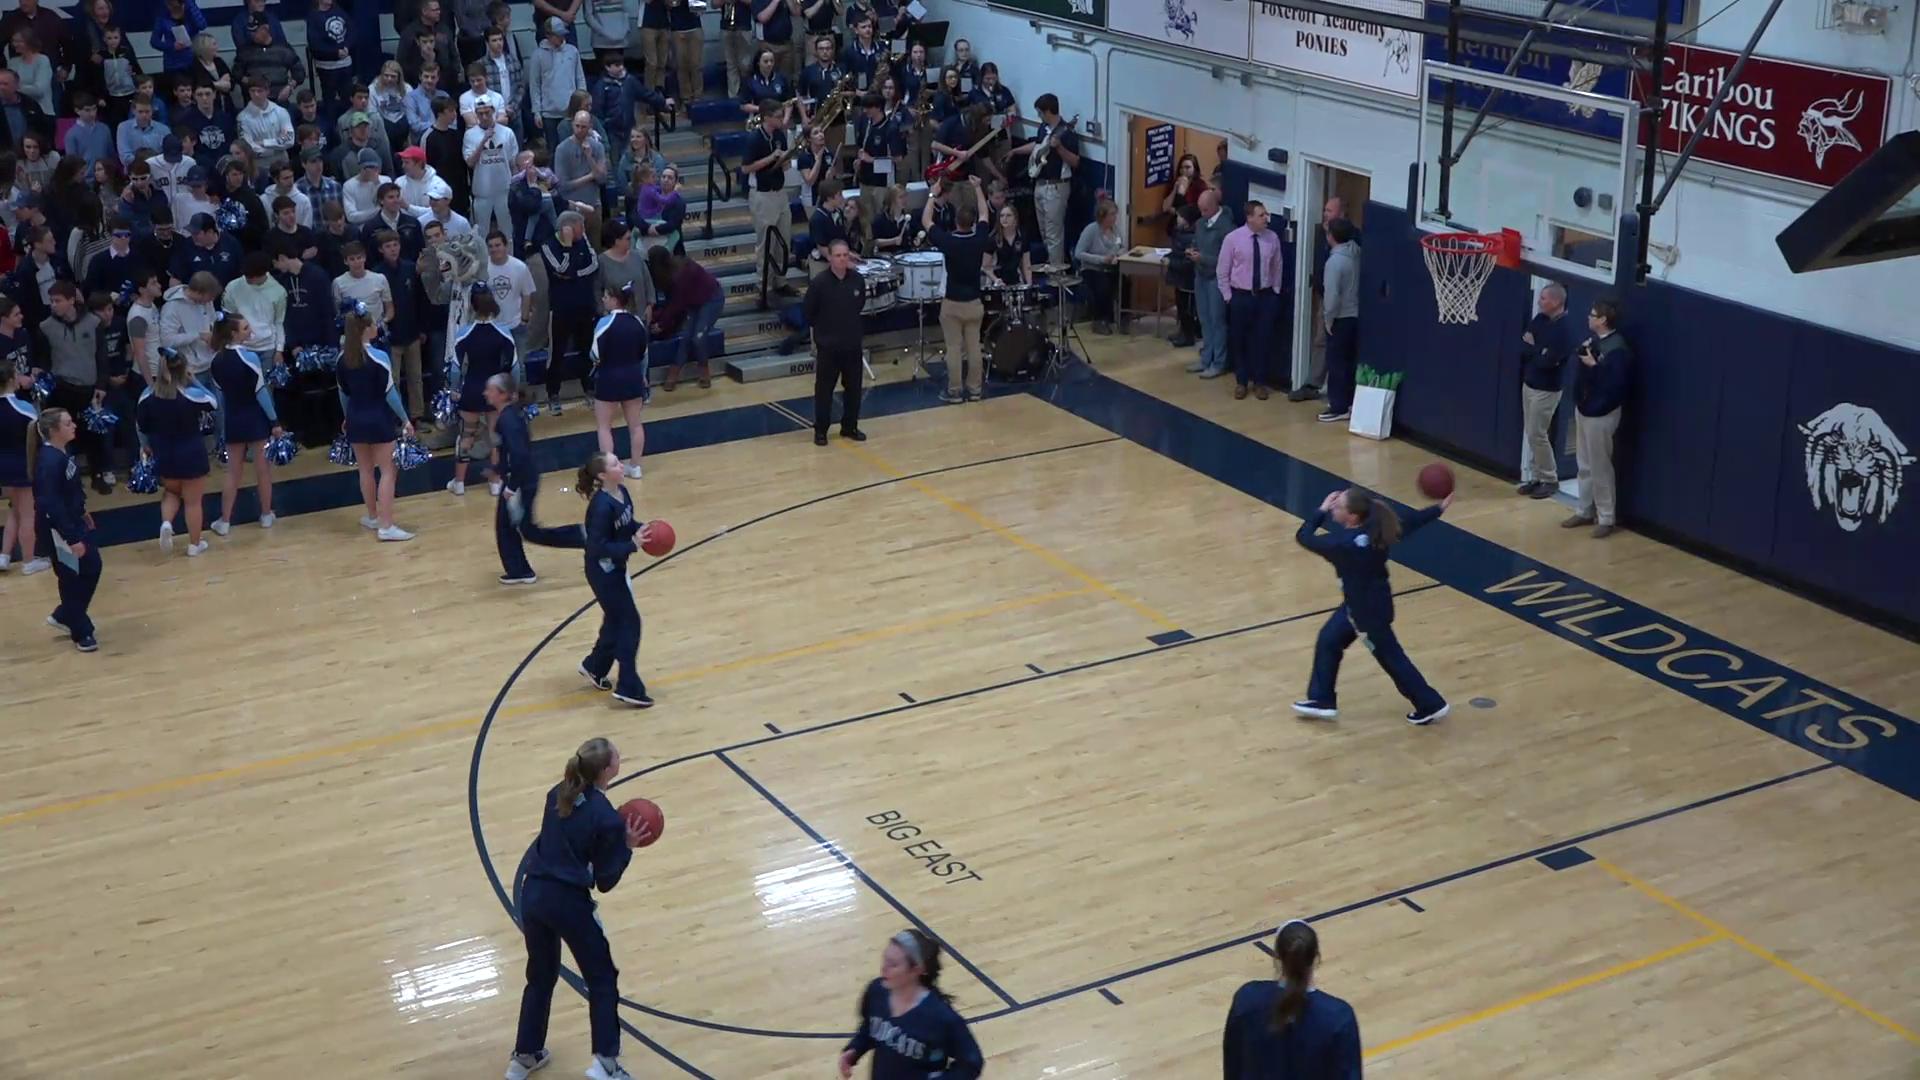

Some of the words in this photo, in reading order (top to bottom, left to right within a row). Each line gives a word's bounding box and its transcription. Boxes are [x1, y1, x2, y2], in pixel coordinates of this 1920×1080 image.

[1260, 3, 1317, 26] Foxcroft
[1322, 15, 1387, 43] Academy
[1295, 30, 1349, 57] PONIES
[1660, 56, 1774, 111] Caribou
[683, 210, 701, 221] OW
[704, 246, 729, 258] ROW
[730, 283, 757, 295] ROW
[758, 321, 783, 333] ROW
[789, 362, 815, 375] ROW
[1484, 570, 1897, 750] WILDCATS
[866, 810, 922, 842] BIG
[903, 839, 984, 885] EAST
